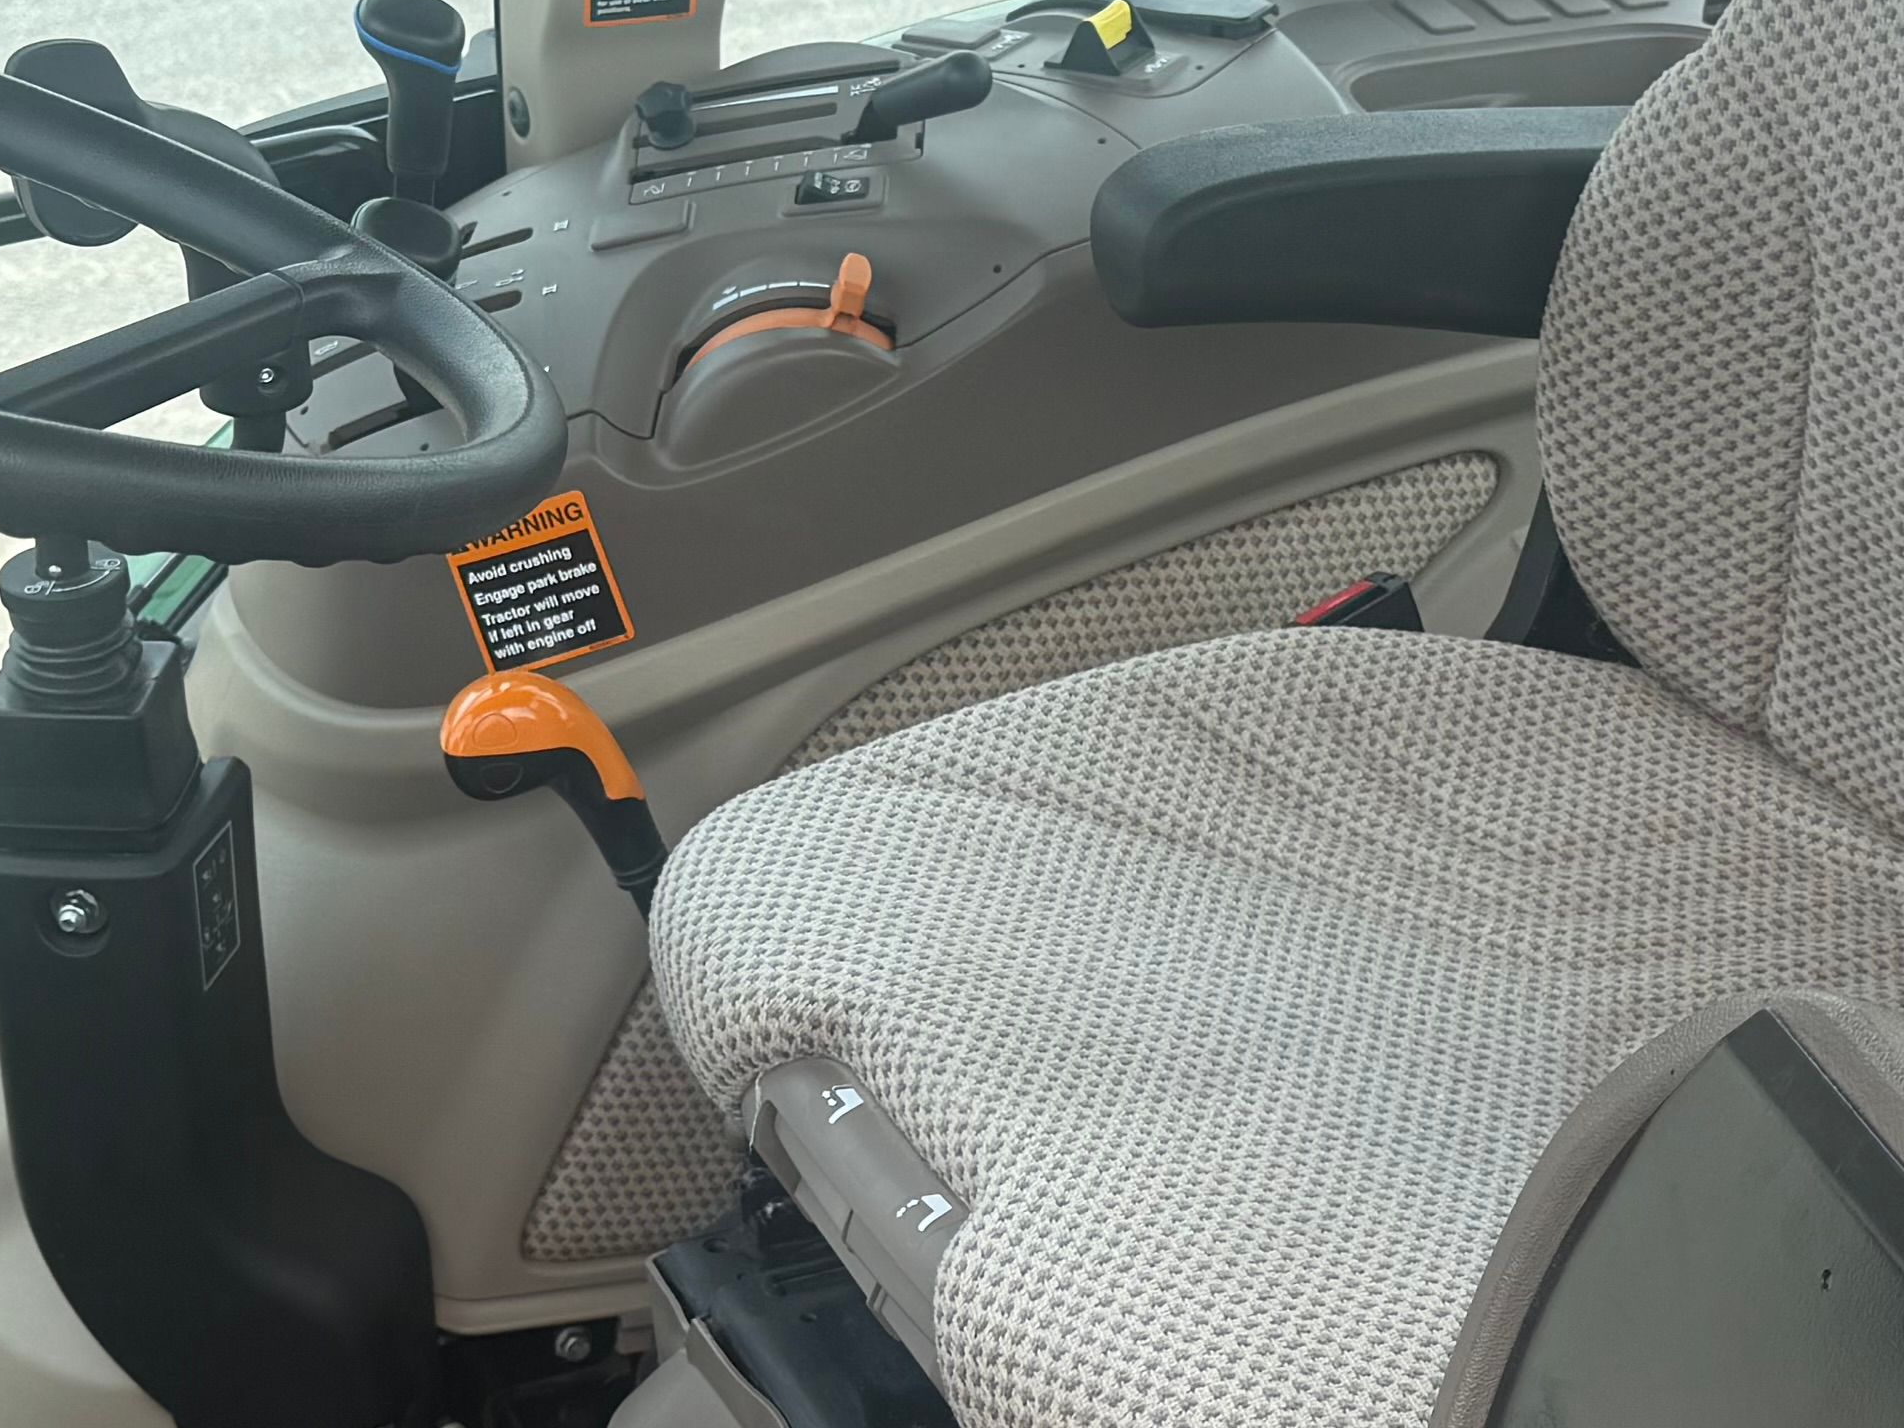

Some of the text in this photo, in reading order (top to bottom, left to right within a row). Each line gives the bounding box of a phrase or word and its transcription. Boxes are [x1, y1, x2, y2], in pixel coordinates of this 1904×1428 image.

[468, 546, 572, 585] Avoid crushing
[474, 561, 597, 606] Engage park brake
[481, 584, 600, 626] Tractor will move
[501, 620, 525, 639] left
[526, 617, 541, 632] in
[544, 609, 575, 630] gear
[494, 642, 525, 659] with
[528, 627, 575, 650] engine
[577, 618, 597, 635] off
